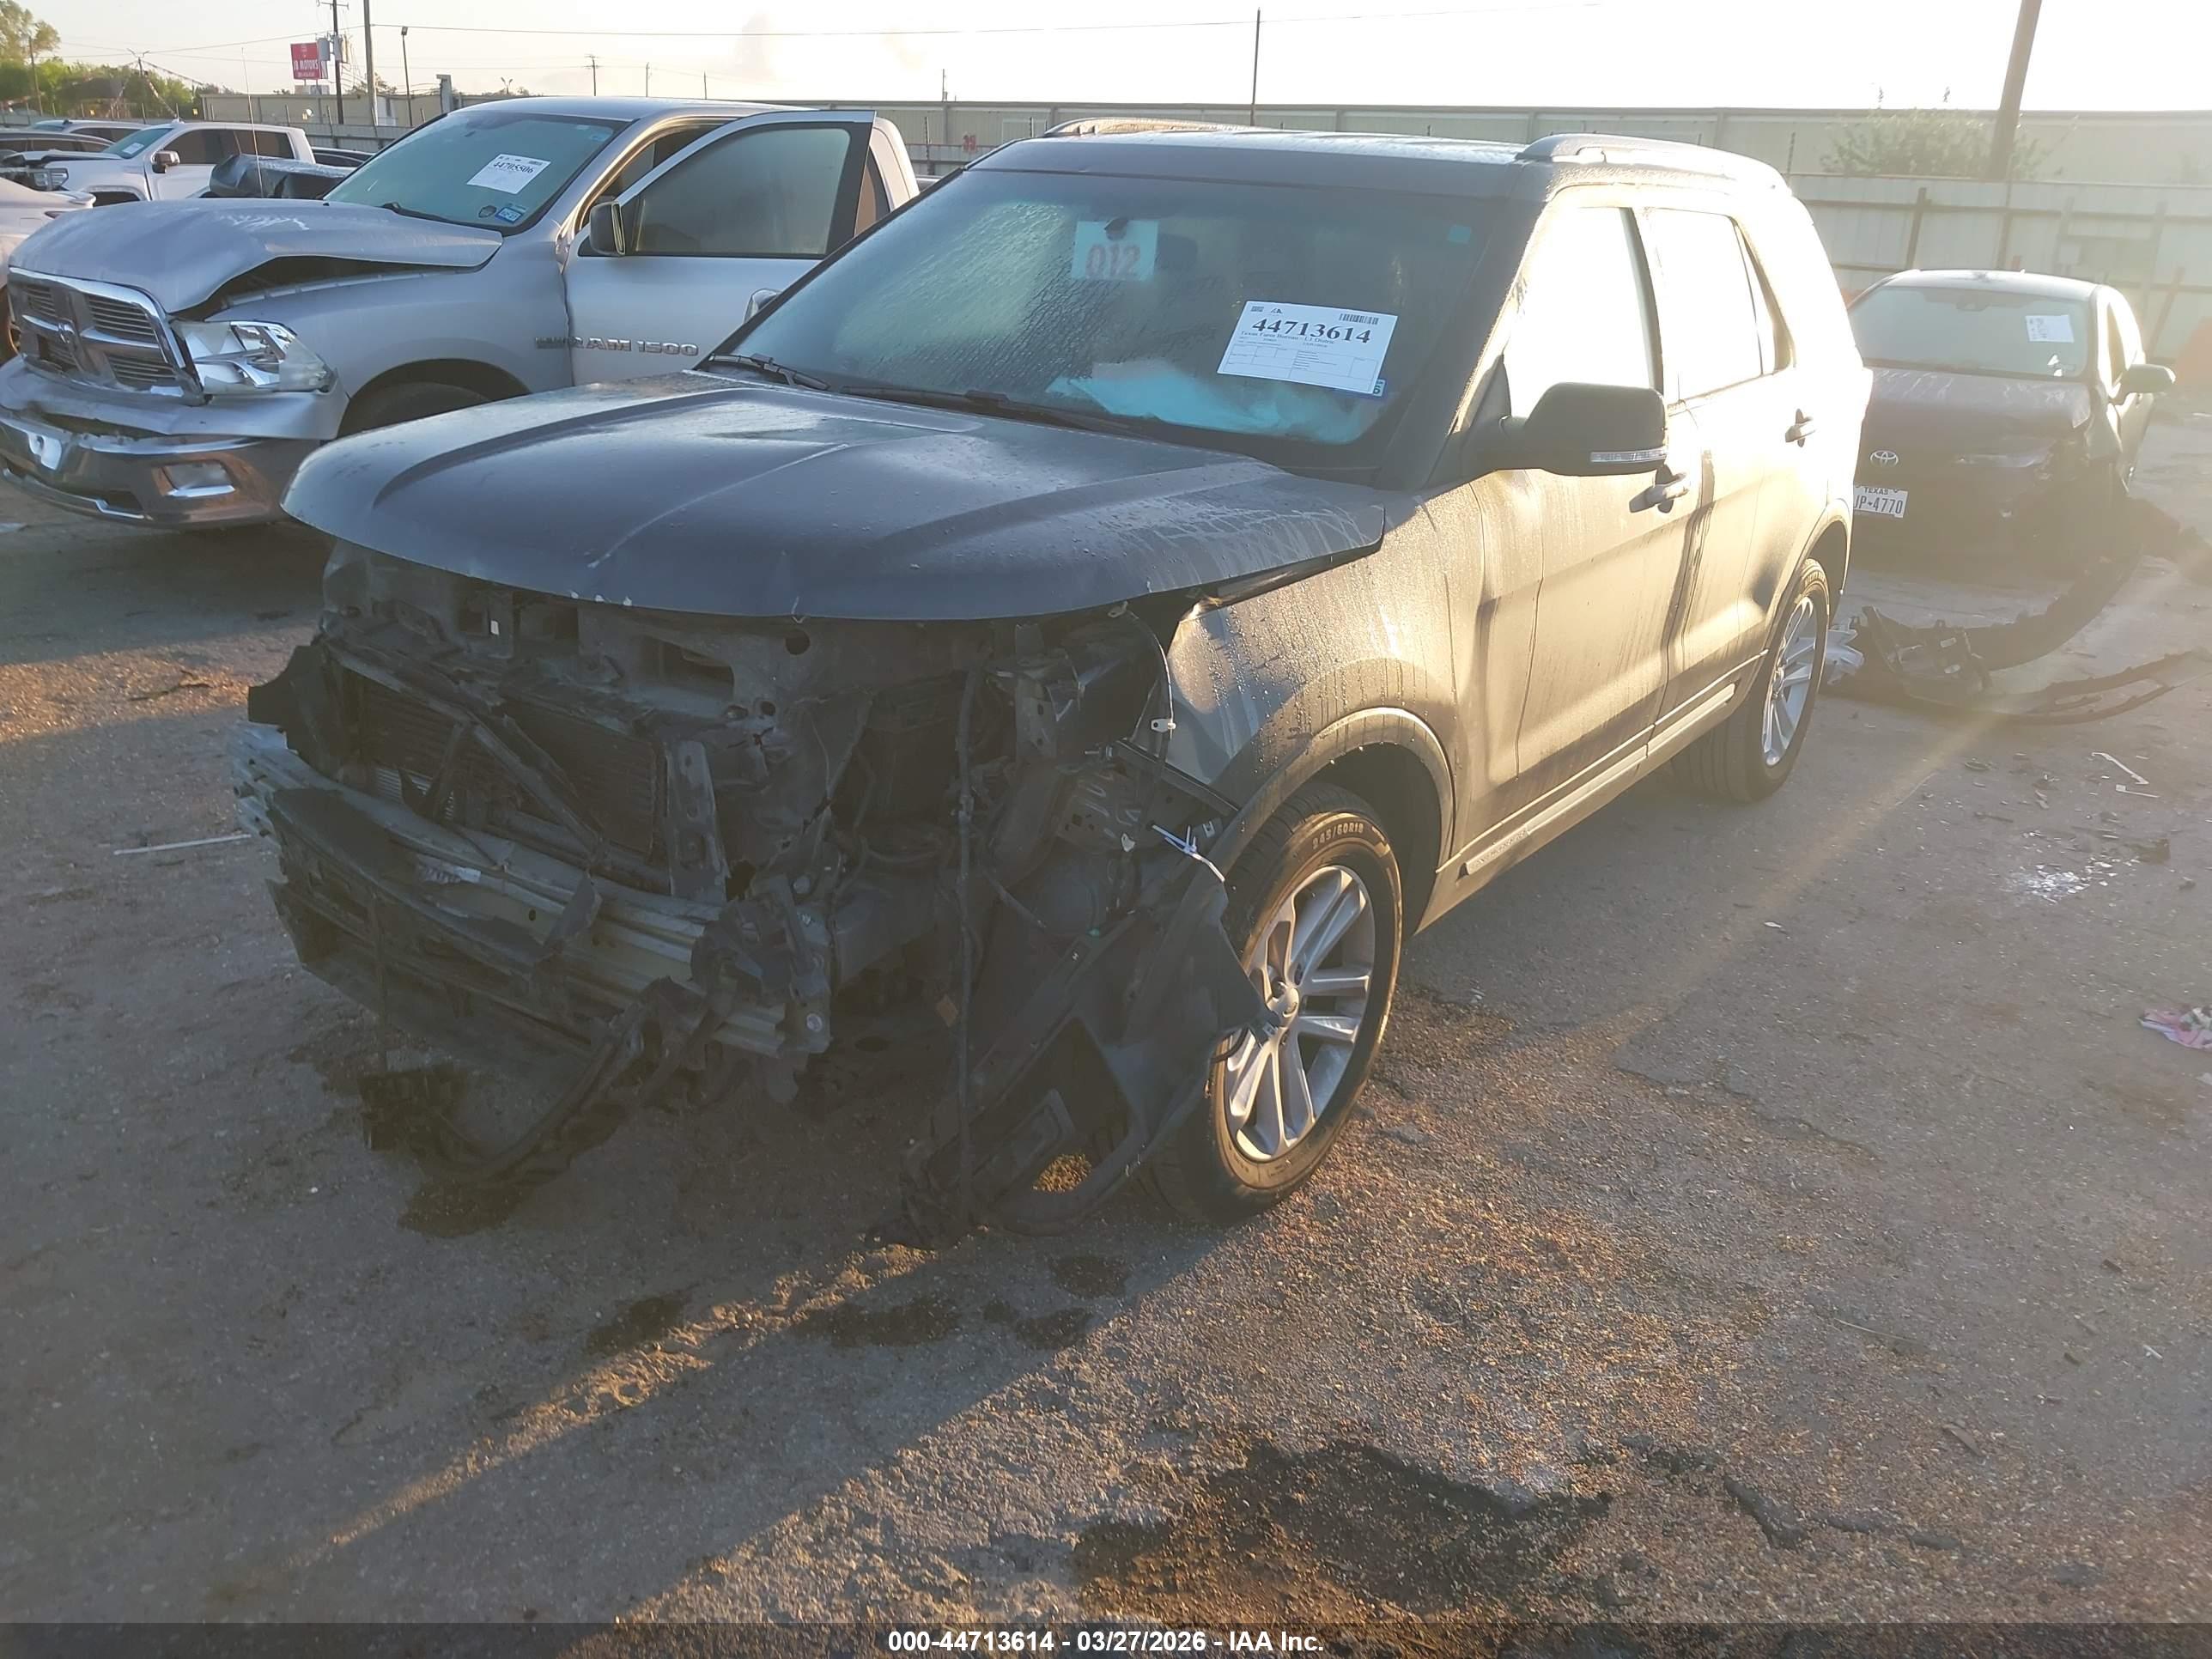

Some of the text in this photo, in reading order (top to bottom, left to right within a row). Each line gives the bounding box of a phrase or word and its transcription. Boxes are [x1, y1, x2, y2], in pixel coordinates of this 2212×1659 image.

[1252, 318, 1371, 344] 44713614
[567, 336, 632, 352] RAM
[637, 340, 699, 356] 1500
[1864, 487, 1889, 495] TEXAS
